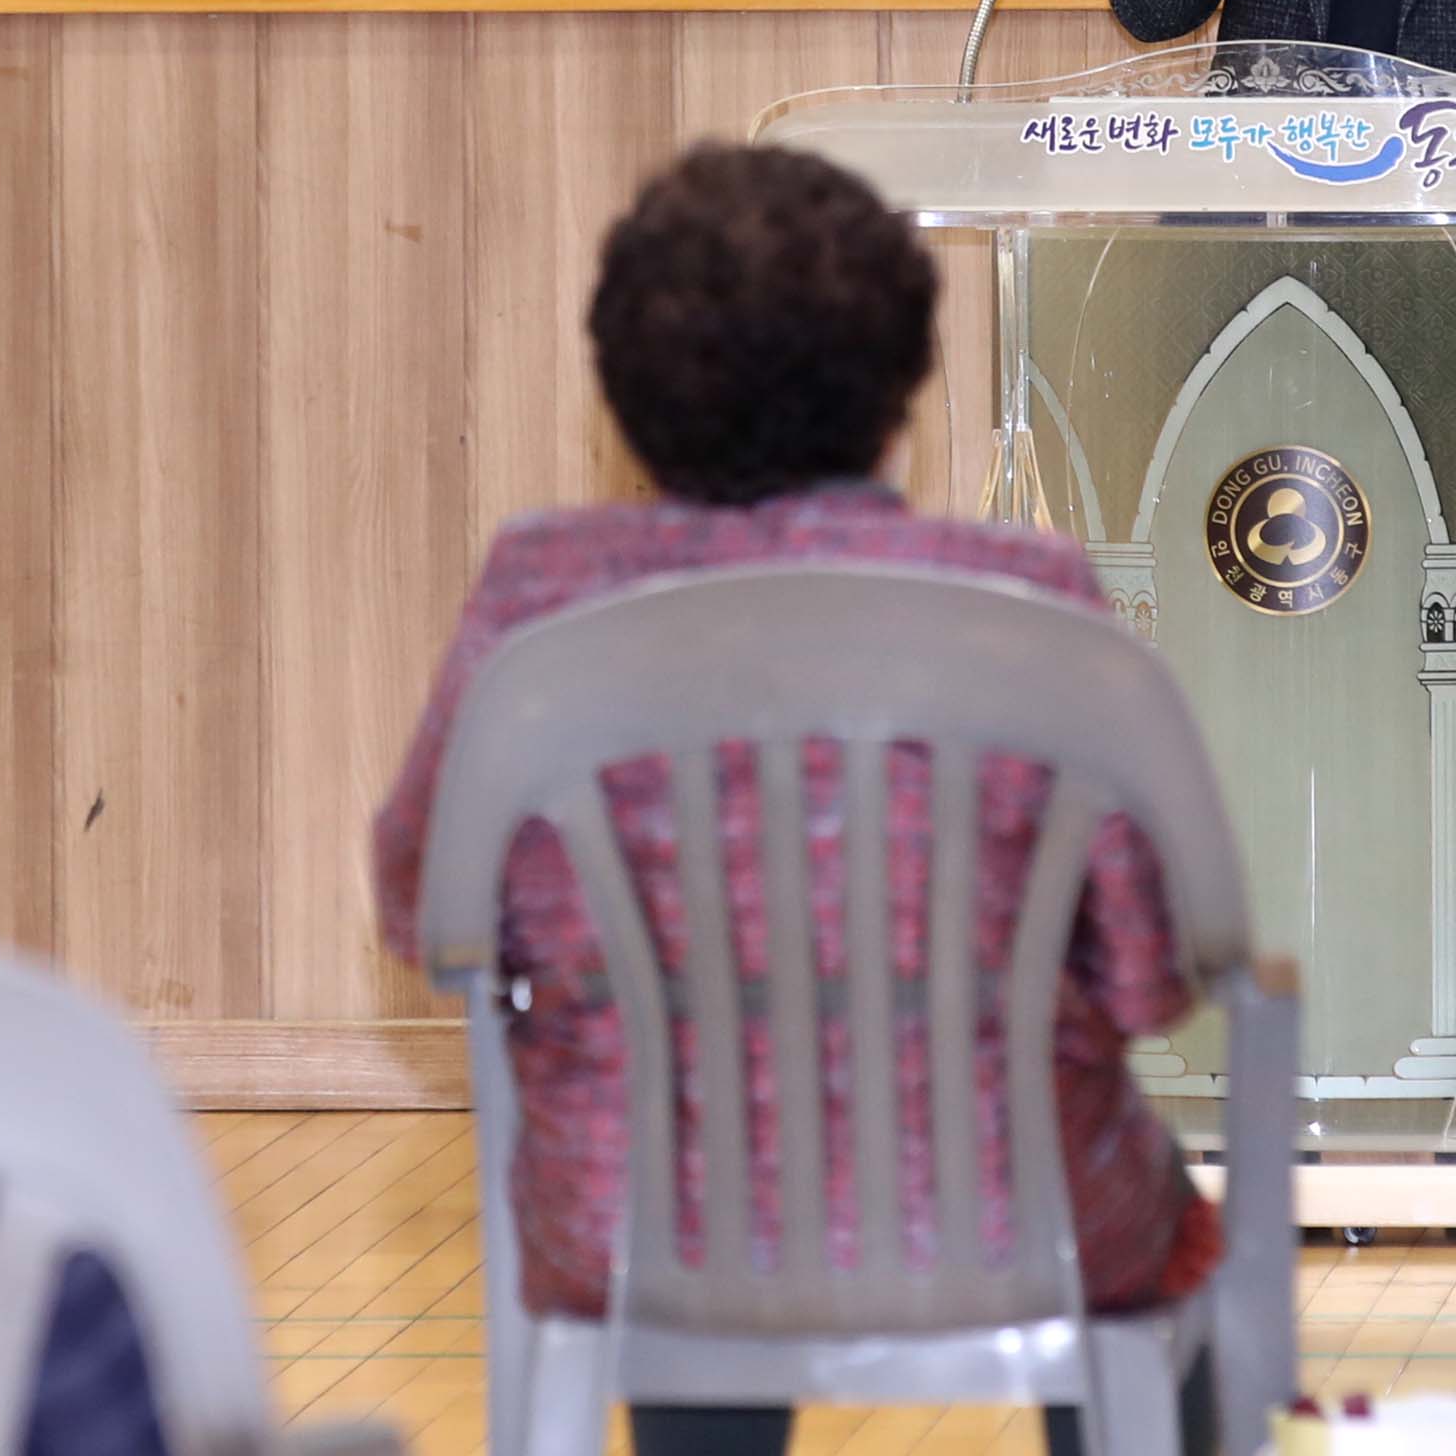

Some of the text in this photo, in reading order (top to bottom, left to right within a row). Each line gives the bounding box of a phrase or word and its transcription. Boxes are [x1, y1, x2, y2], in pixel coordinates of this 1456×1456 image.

[1023, 115, 1102, 153] 새로운
[1108, 113, 1179, 153] 변화
[1191, 116, 1273, 160] 모두가
[1281, 112, 1372, 161] 행복한
[1211, 469, 1250, 526] DONG
[1295, 455, 1364, 527] INCHEON
